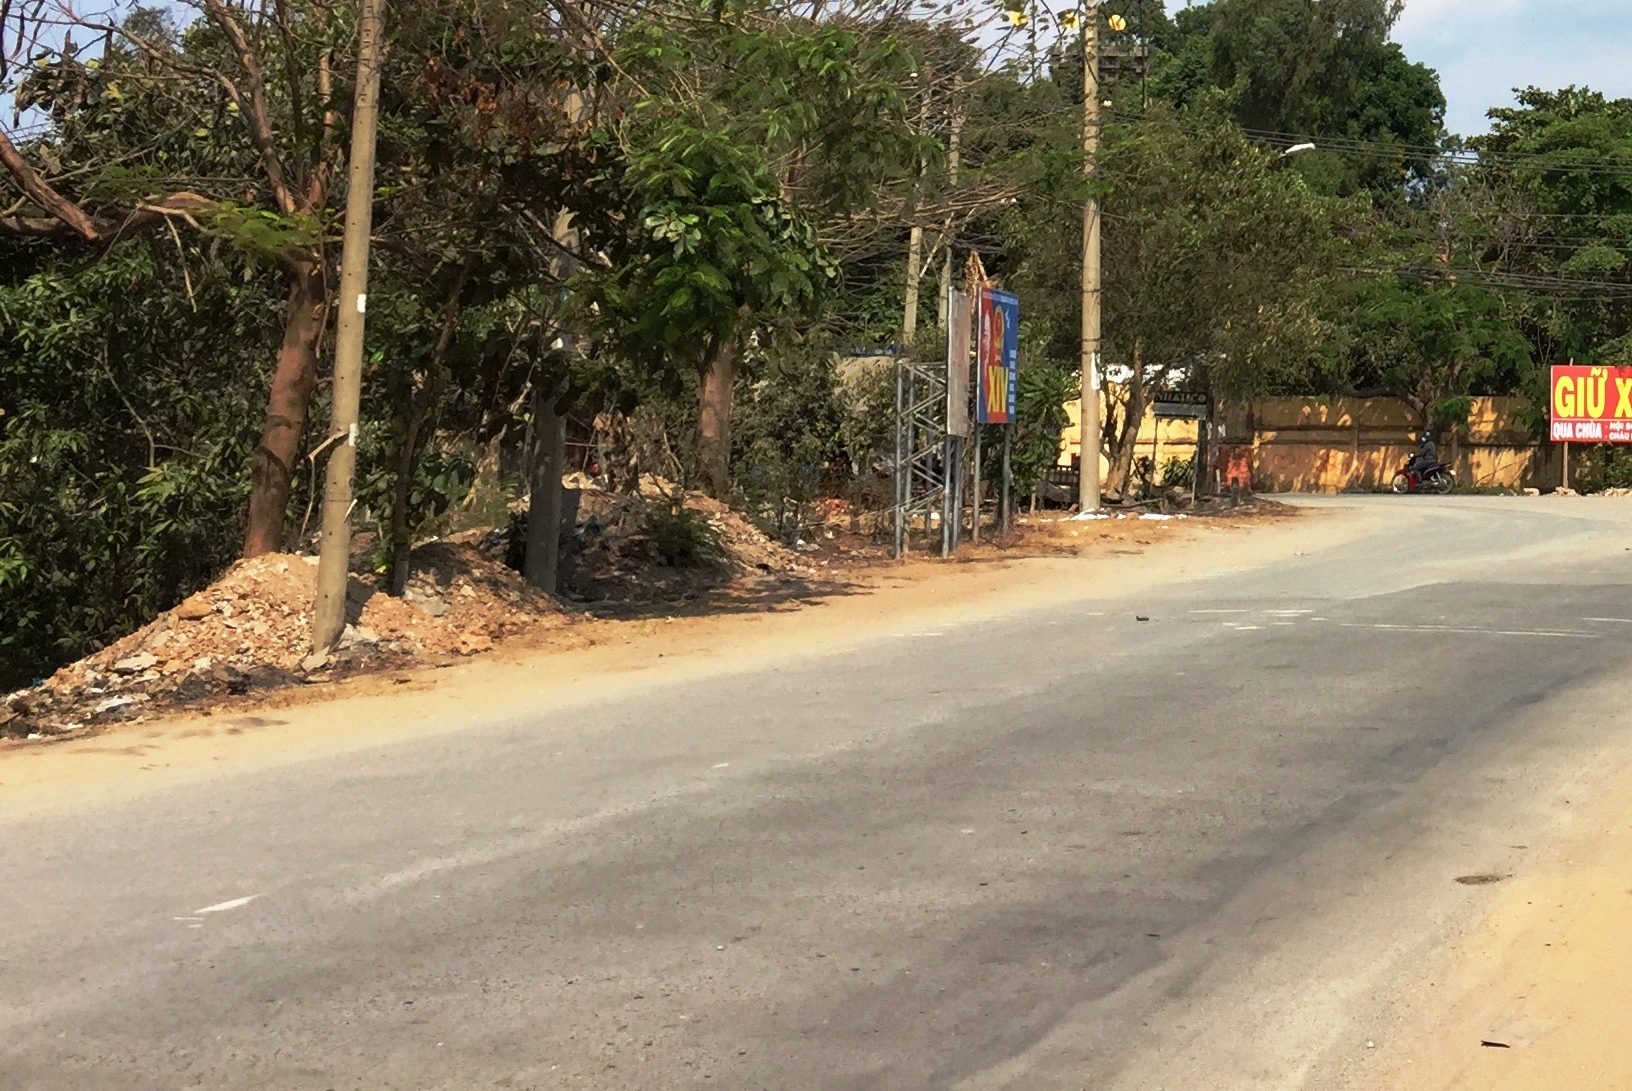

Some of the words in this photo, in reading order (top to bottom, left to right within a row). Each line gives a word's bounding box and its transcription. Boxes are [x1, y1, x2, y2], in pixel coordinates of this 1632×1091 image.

[1555, 367, 1608, 418] GIỮ
[1553, 422, 1574, 440] QUA
[1575, 419, 1603, 439] CHÙA
